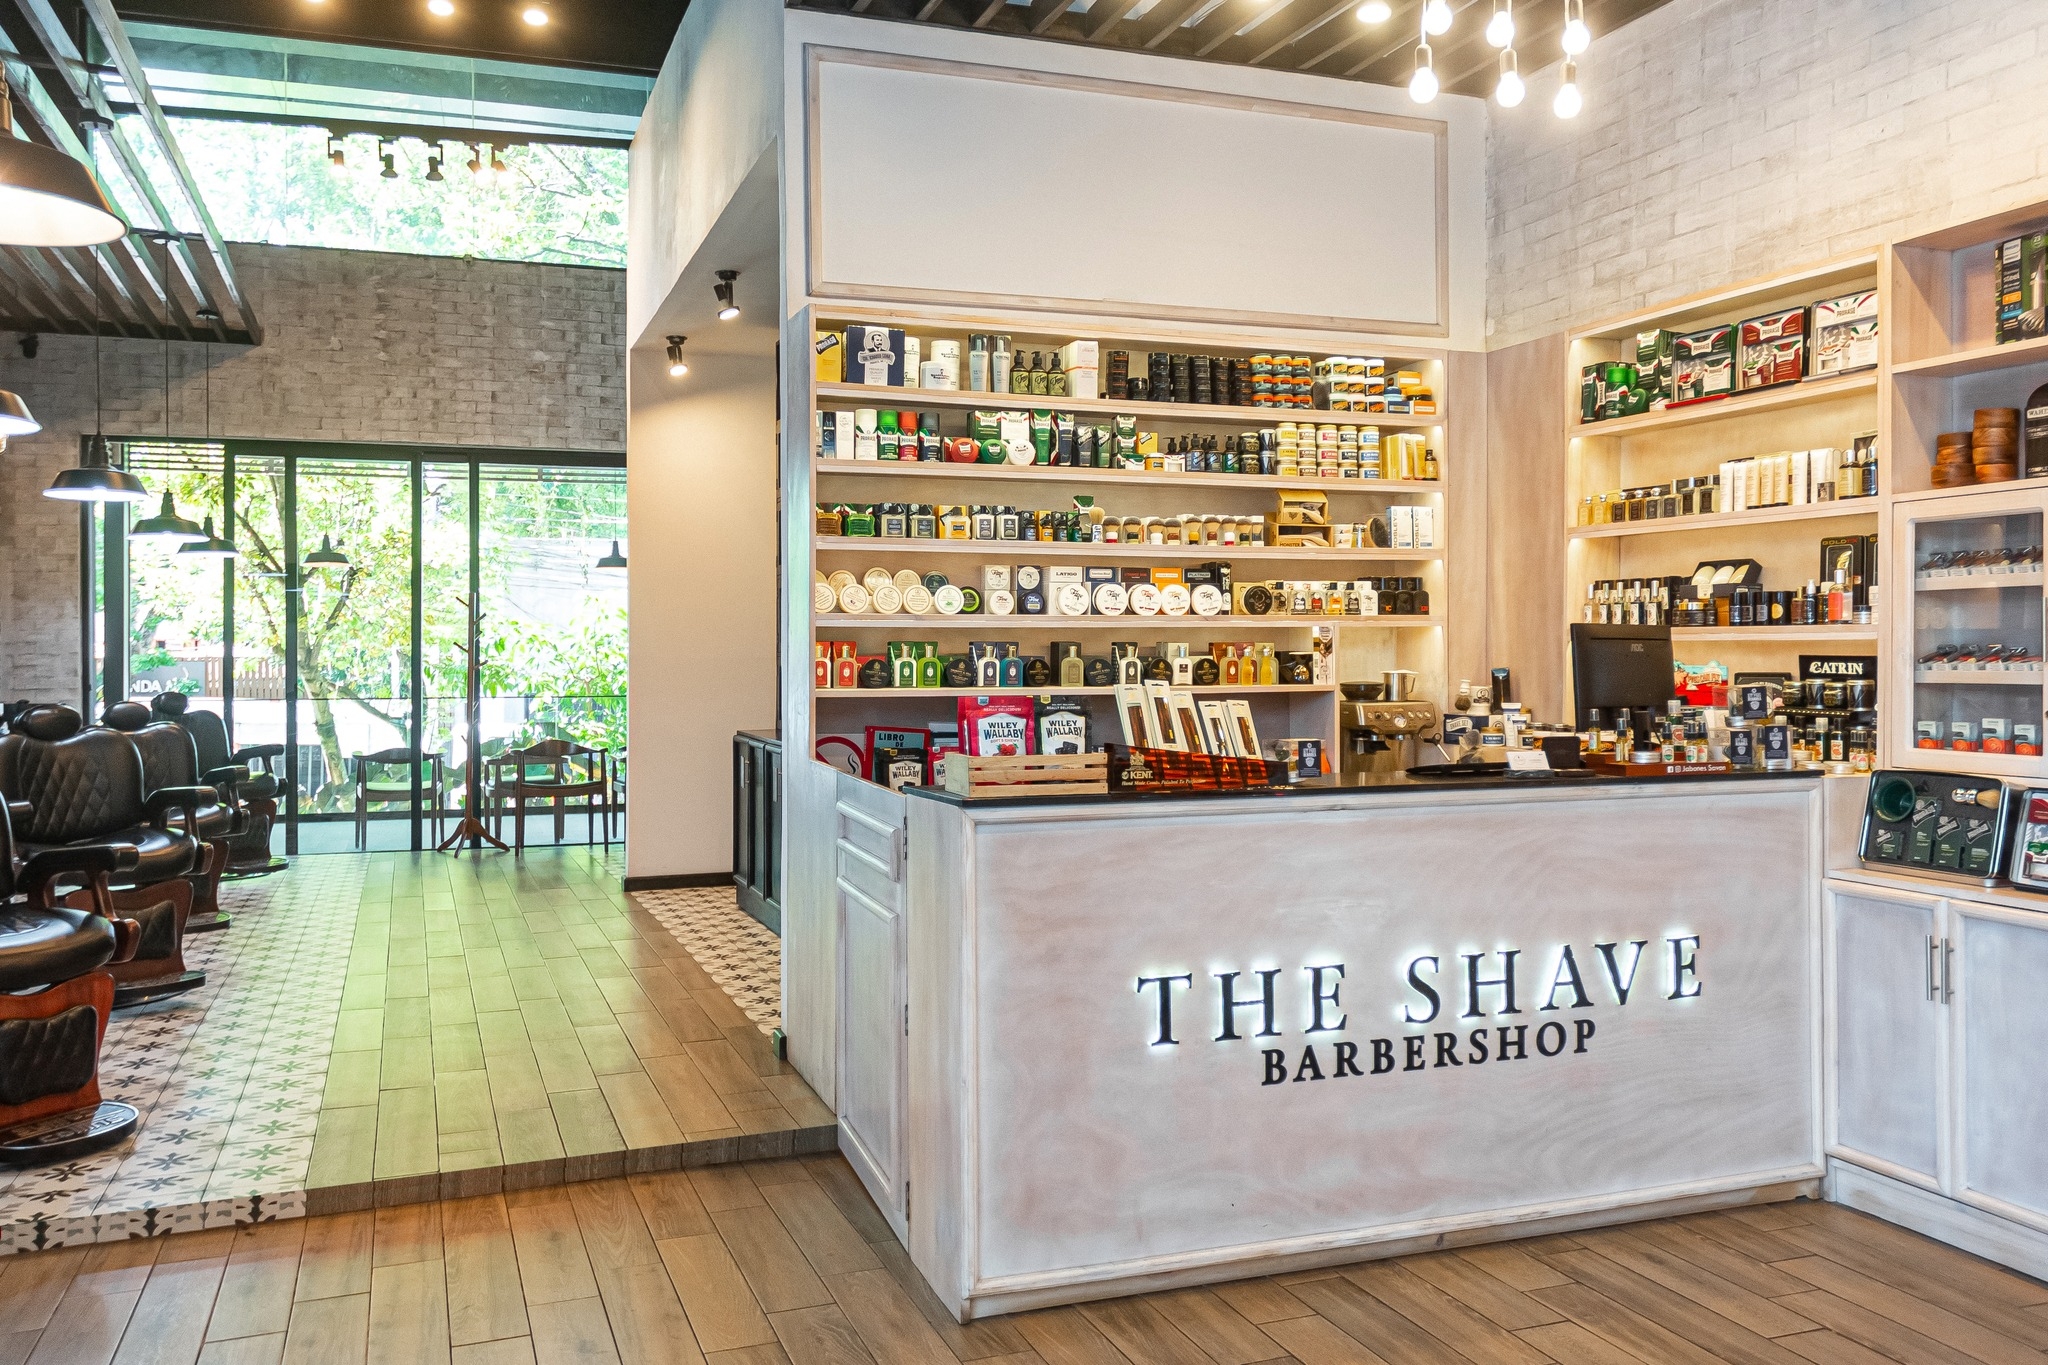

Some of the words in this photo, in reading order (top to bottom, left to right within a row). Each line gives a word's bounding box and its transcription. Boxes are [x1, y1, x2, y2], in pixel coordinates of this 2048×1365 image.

[1809, 661, 1863, 675] CATRIN
[879, 733, 904, 741] LIBRO
[984, 729, 1024, 740] WALLABY
[1046, 727, 1082, 738] WALLABY
[892, 770, 920, 779] WALLABY
[1135, 961, 1348, 1047] THE
[1402, 934, 1701, 1025] SHAVE
[1261, 1018, 1597, 1086] BARBERSHOP
